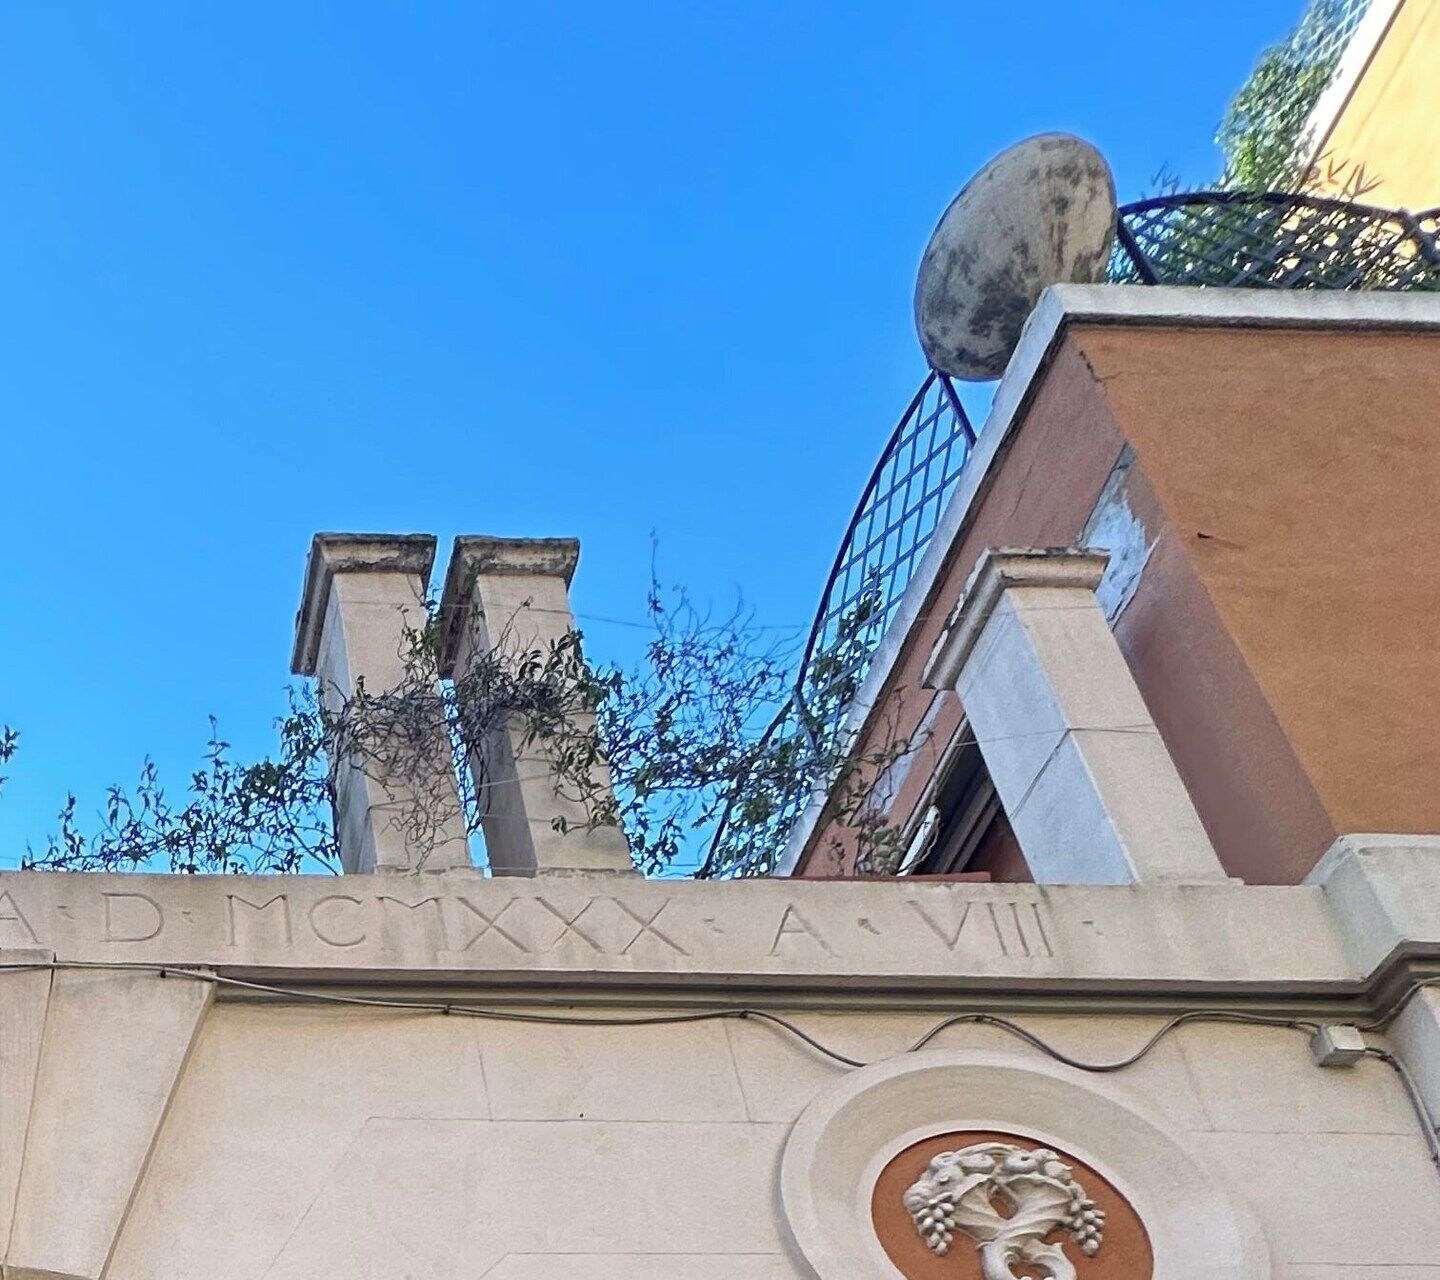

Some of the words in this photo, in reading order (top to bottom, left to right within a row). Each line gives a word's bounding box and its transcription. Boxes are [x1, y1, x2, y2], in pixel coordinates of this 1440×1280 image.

[98, 892, 165, 944] D
[223, 893, 692, 957] MCMXXX
[767, 901, 839, 959] A
[907, 899, 1059, 960] VIII
